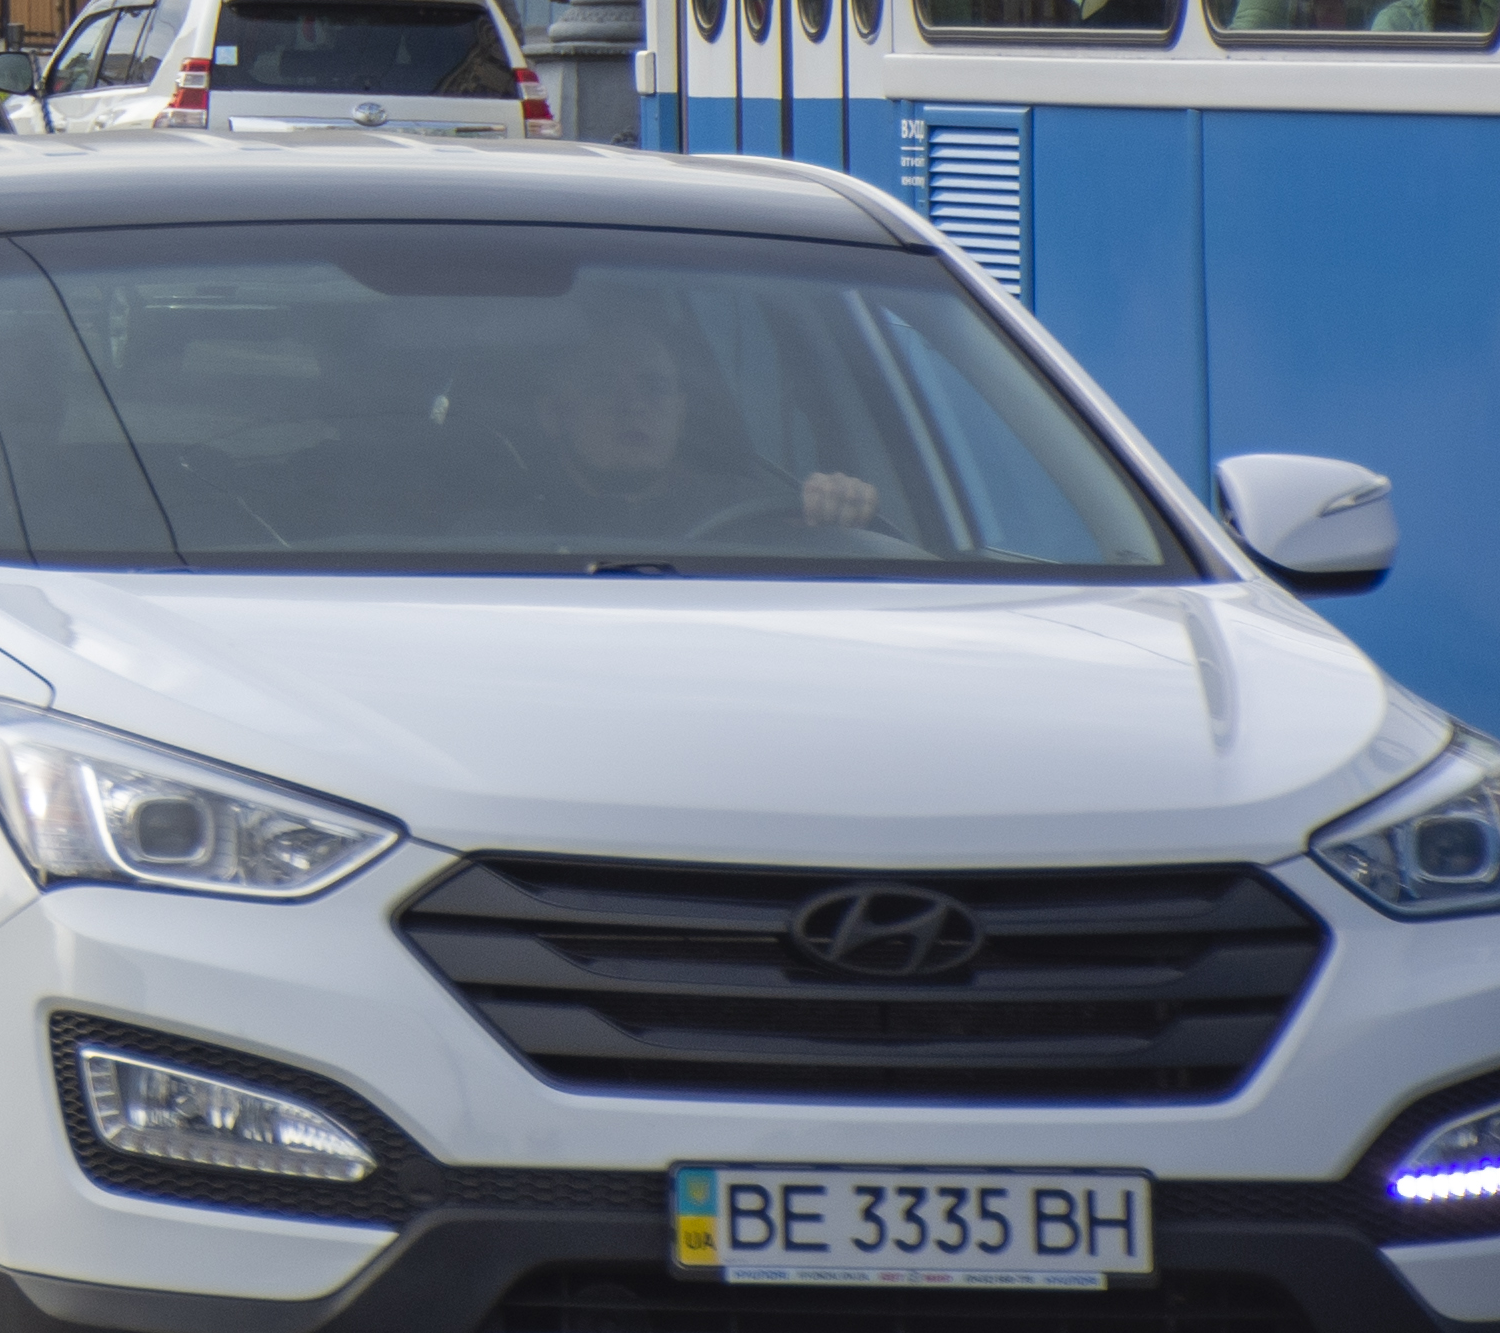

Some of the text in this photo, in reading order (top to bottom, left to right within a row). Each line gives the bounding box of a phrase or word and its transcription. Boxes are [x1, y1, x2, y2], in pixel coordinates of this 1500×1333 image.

[684, 1183, 1136, 1257] UA BE 3335 BH
